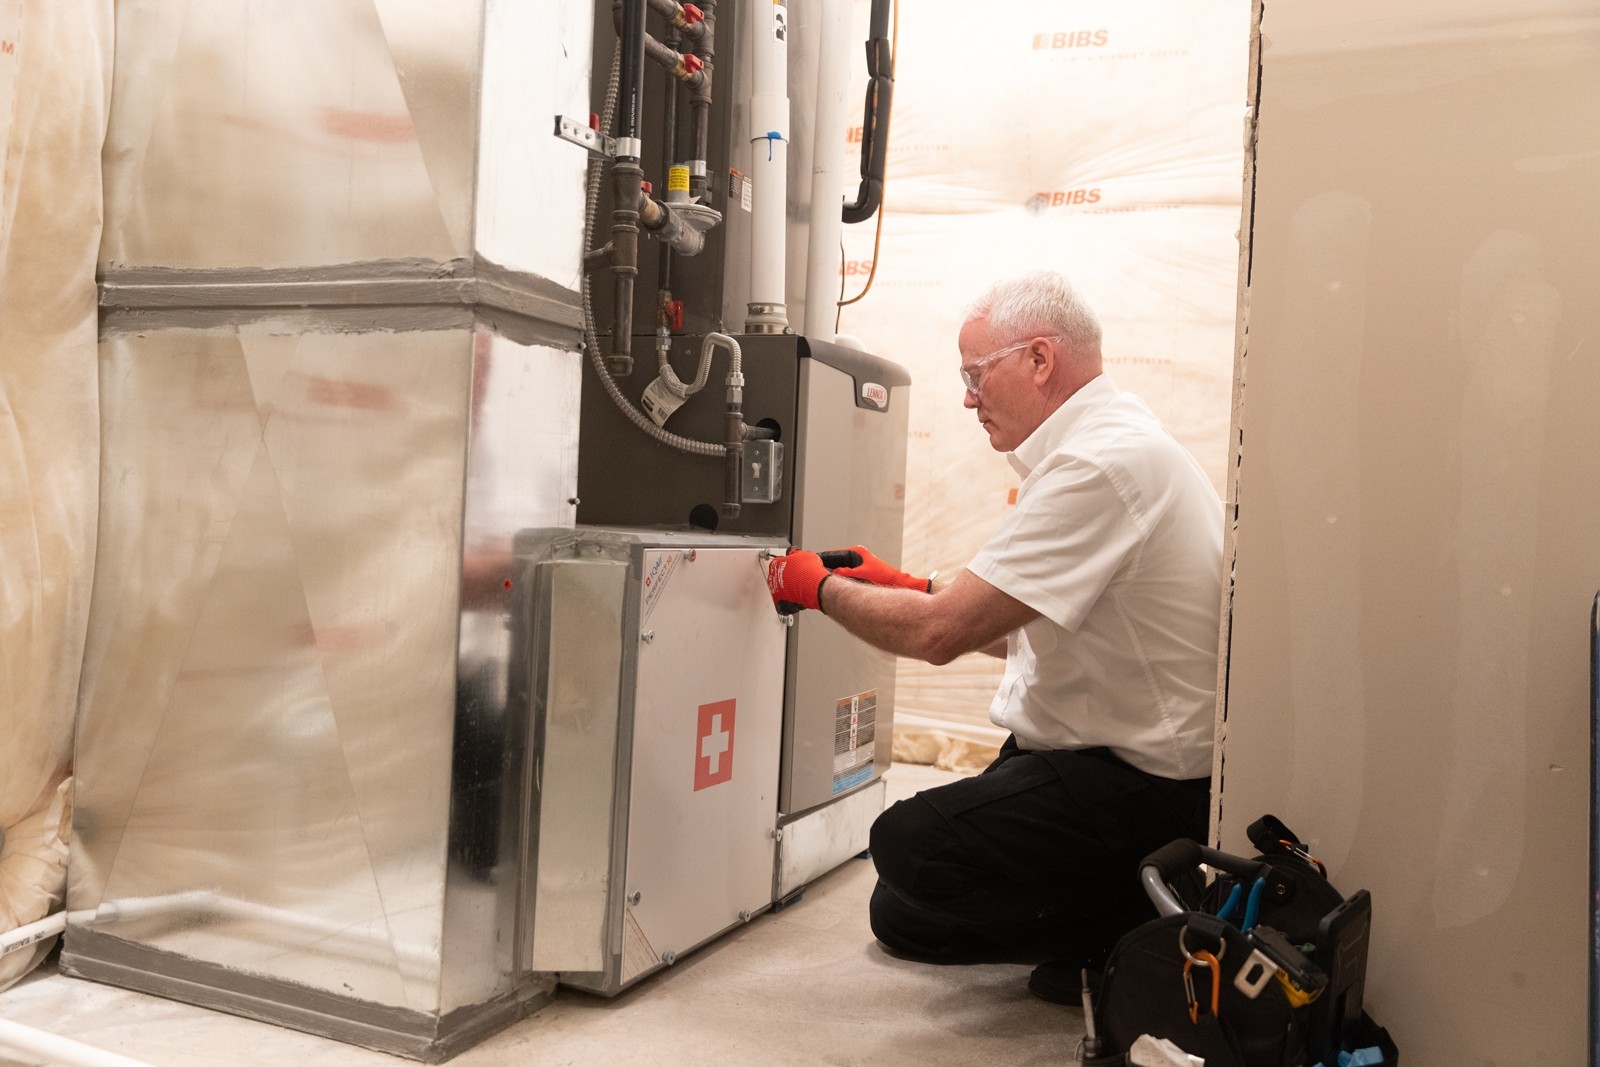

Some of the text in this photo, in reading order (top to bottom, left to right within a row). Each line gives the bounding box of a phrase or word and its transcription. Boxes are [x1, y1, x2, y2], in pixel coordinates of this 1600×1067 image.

[1052, 29, 1109, 49] BIBS
[1052, 188, 1103, 207] BIBS
[645, 566, 668, 606] PERFECT
